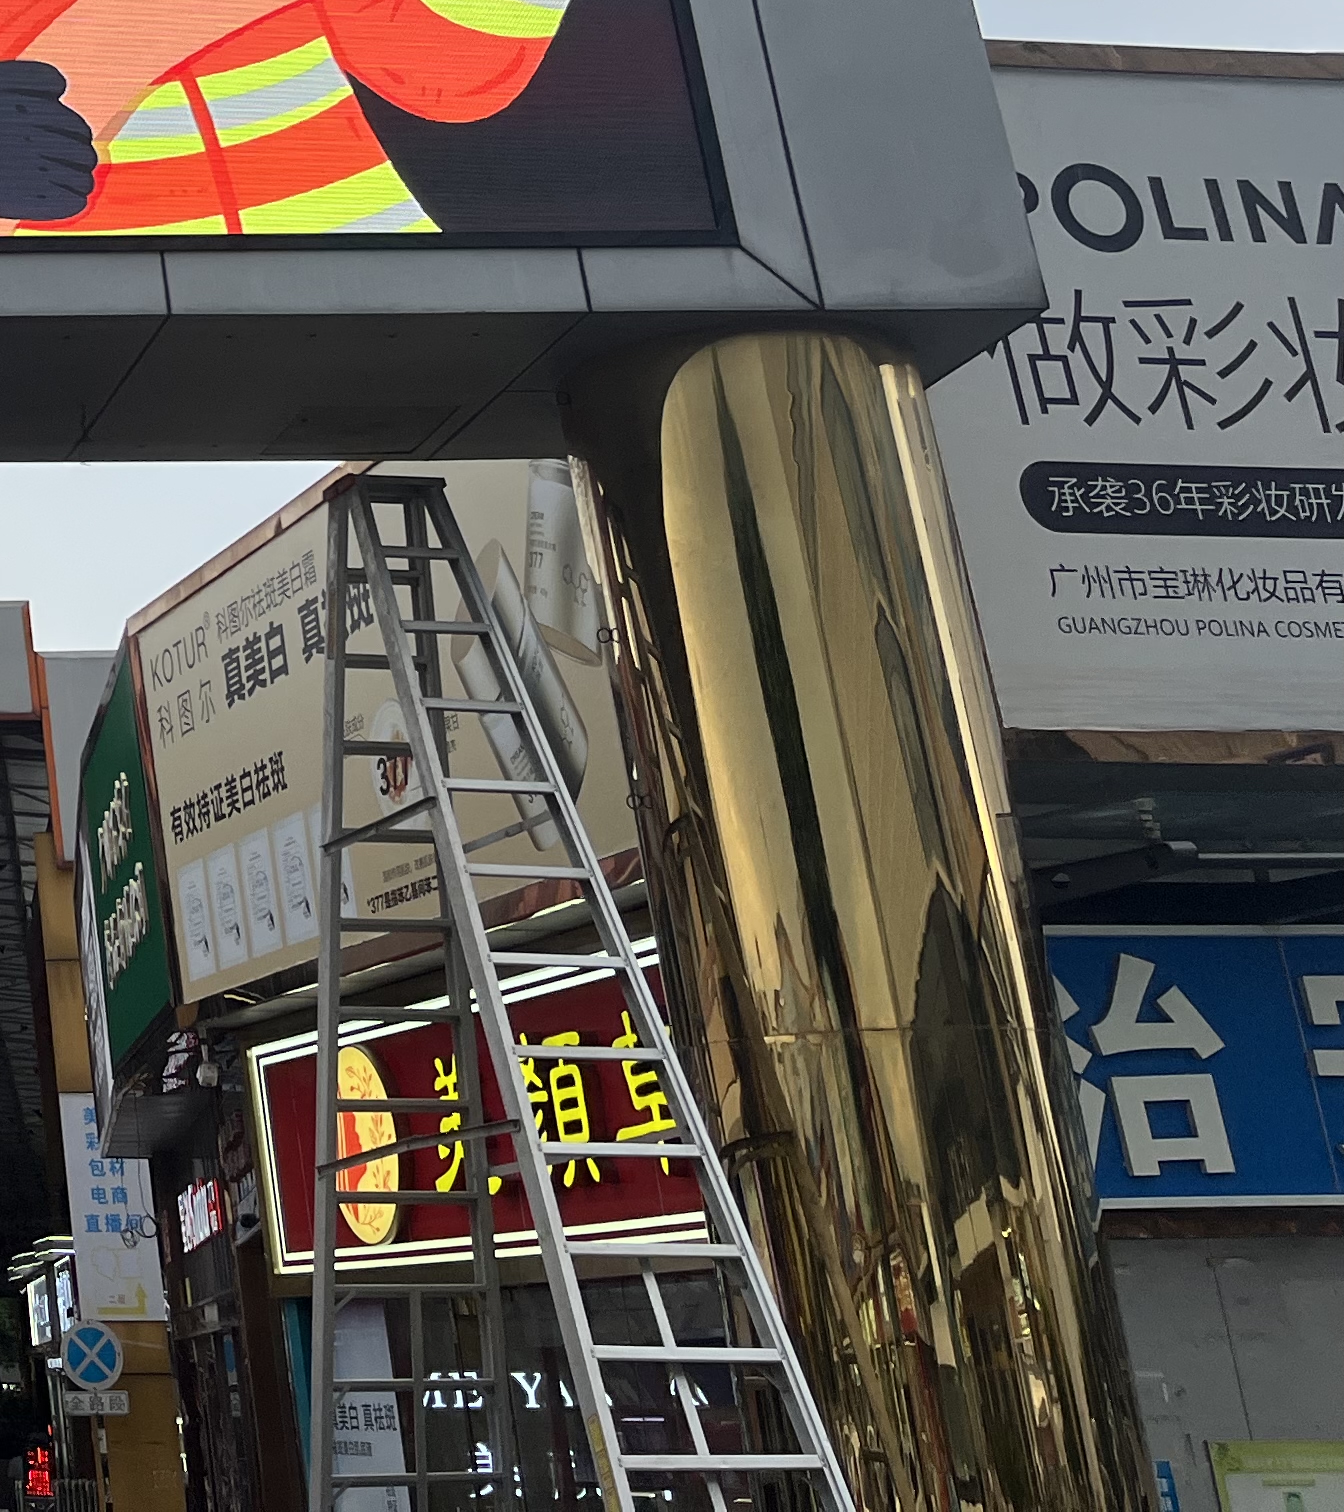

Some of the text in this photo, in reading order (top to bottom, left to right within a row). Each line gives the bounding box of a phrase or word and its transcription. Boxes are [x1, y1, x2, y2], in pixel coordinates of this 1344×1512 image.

[215, 550, 318, 645] 科图尔祛斑美白霜
[1050, 565, 1344, 605] 广州市宝琳化妆品有
[1058, 616, 1190, 638] GUANGZHOU
[1196, 618, 1270, 638] POLINA
[150, 625, 210, 692] KOTUR
[222, 584, 375, 710] 真美白 真斑
[157, 678, 216, 748] 科图尔
[170, 751, 288, 845] 有效持证美白祛斑
[88, 1158, 126, 1178] 包材
[90, 1187, 128, 1206] 电商
[84, 1213, 143, 1234] 直播间
[69, 1395, 126, 1412] 全路段
[332, 1402, 398, 1432] 美白 真祛斑
